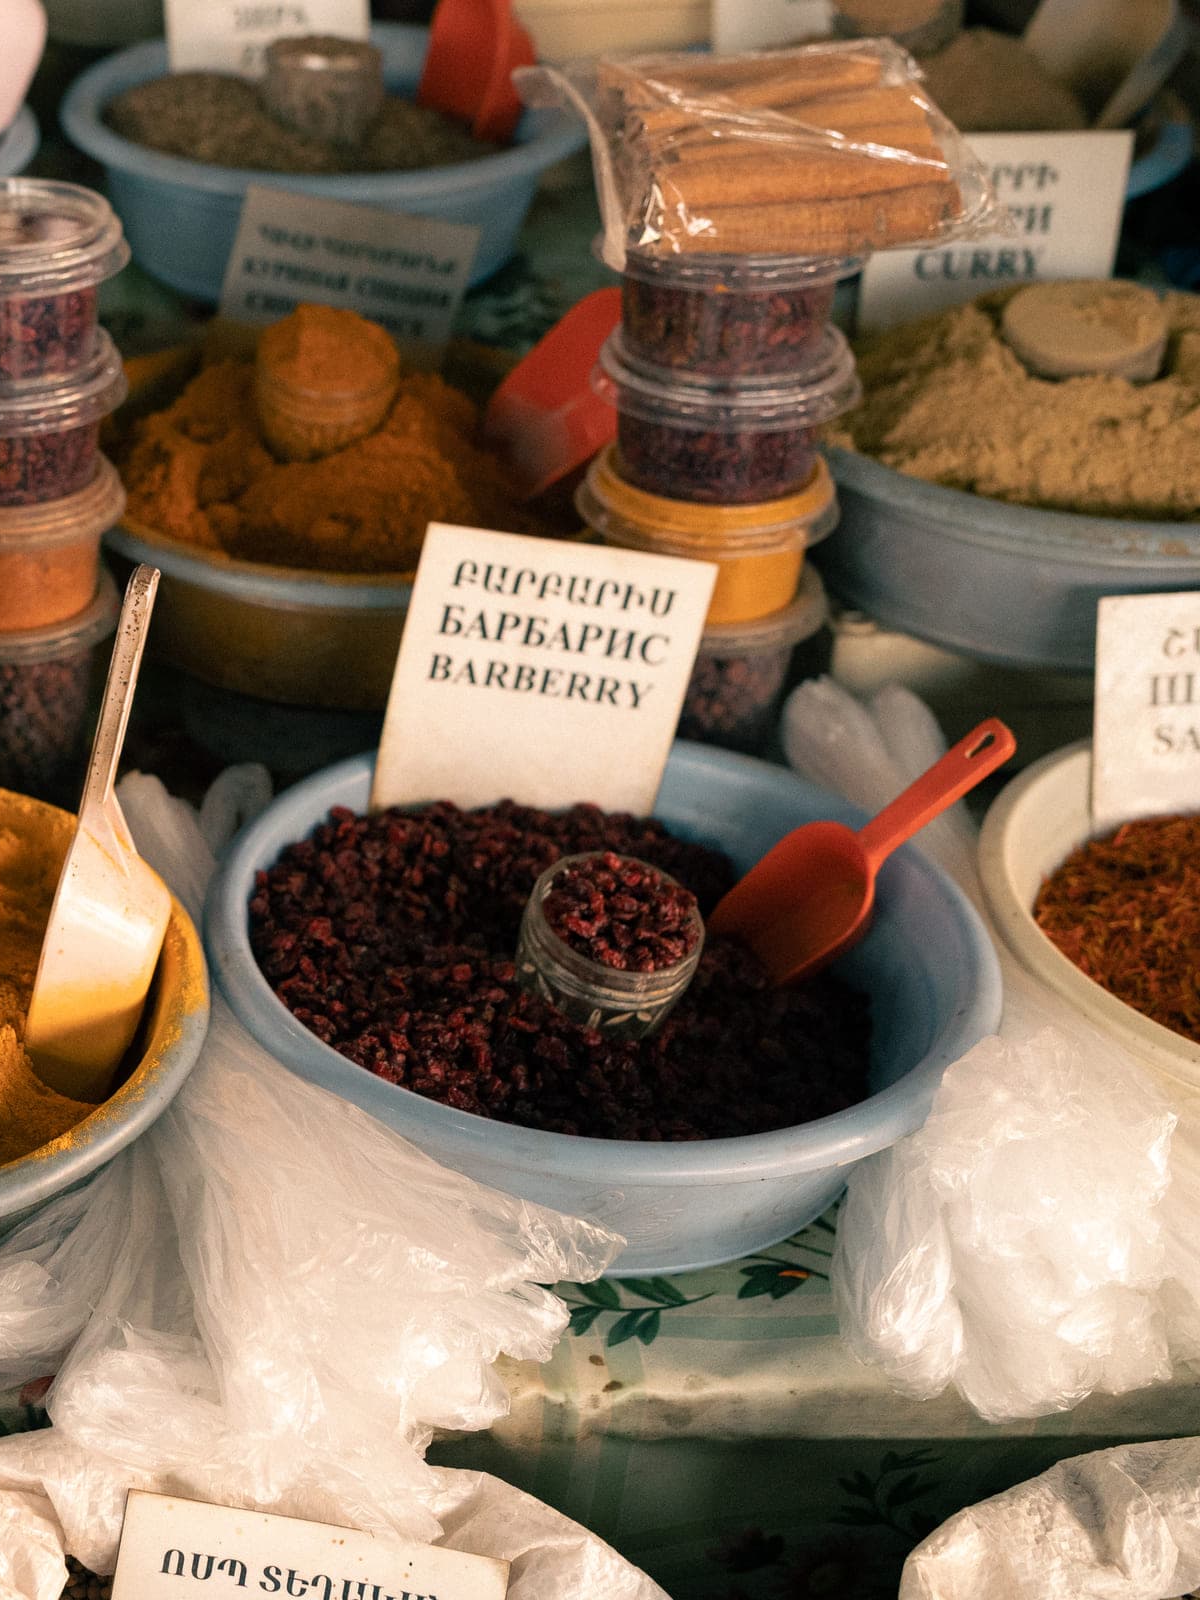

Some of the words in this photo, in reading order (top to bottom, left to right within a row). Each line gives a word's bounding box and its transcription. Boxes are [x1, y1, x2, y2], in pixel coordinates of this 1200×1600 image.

[451, 559, 679, 618] ԲԱՐԲԱՐԻՍ
[437, 603, 671, 667] БАРБАРИС
[426, 652, 655, 710] BARBERRY
[158, 1547, 249, 1589] ՈՍՊ
